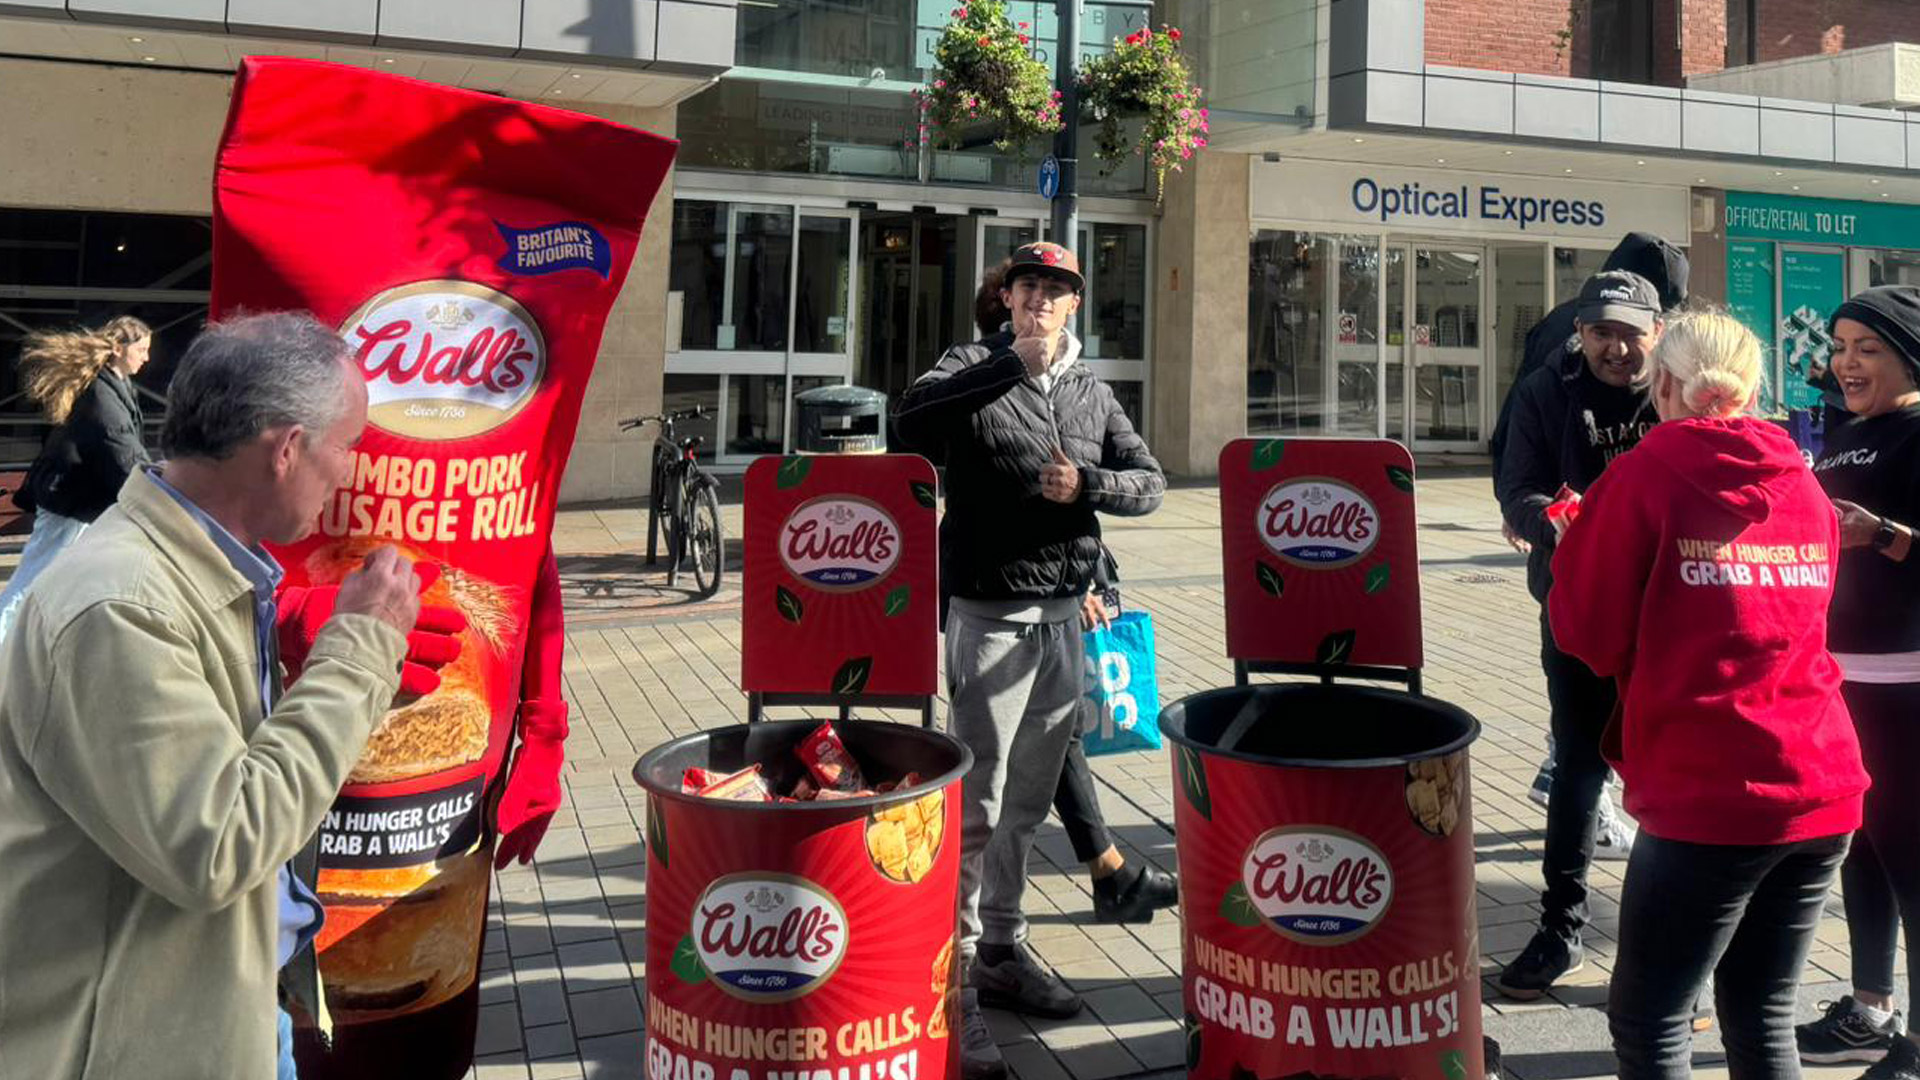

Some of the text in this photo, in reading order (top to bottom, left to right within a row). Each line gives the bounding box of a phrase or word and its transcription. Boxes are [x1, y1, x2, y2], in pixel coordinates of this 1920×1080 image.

[1352, 178, 1605, 230] Optical Express
[1725, 206, 1857, 235] OFFICE/RETAIL TO LET
[517, 226, 593, 251] BRITAIN'S
[517, 242, 595, 267] FAVOURITE
[356, 320, 534, 393] Wall's
[343, 450, 527, 498] UMBO PORK
[321, 480, 539, 541] USAGE ROLL
[1265, 499, 1374, 543] Wall's
[788, 519, 895, 563] Wall's
[1677, 537, 1828, 563] WHEN HUNGER CALL
[1680, 560, 1753, 586] GRAB
[1759, 565, 1775, 586] A
[345, 806, 423, 832] HUNGER
[427, 792, 475, 824] CALLS
[320, 822, 451, 855] RAB A WALL'S
[1252, 853, 1386, 909] Wall's
[700, 903, 839, 962] Wall's
[1194, 934, 1459, 999] WHEN HUNGER CALLS,
[650, 995, 921, 1061] WHEN HUNGER CALLS,
[1194, 975, 1459, 1049] GRAB A WALL'S!
